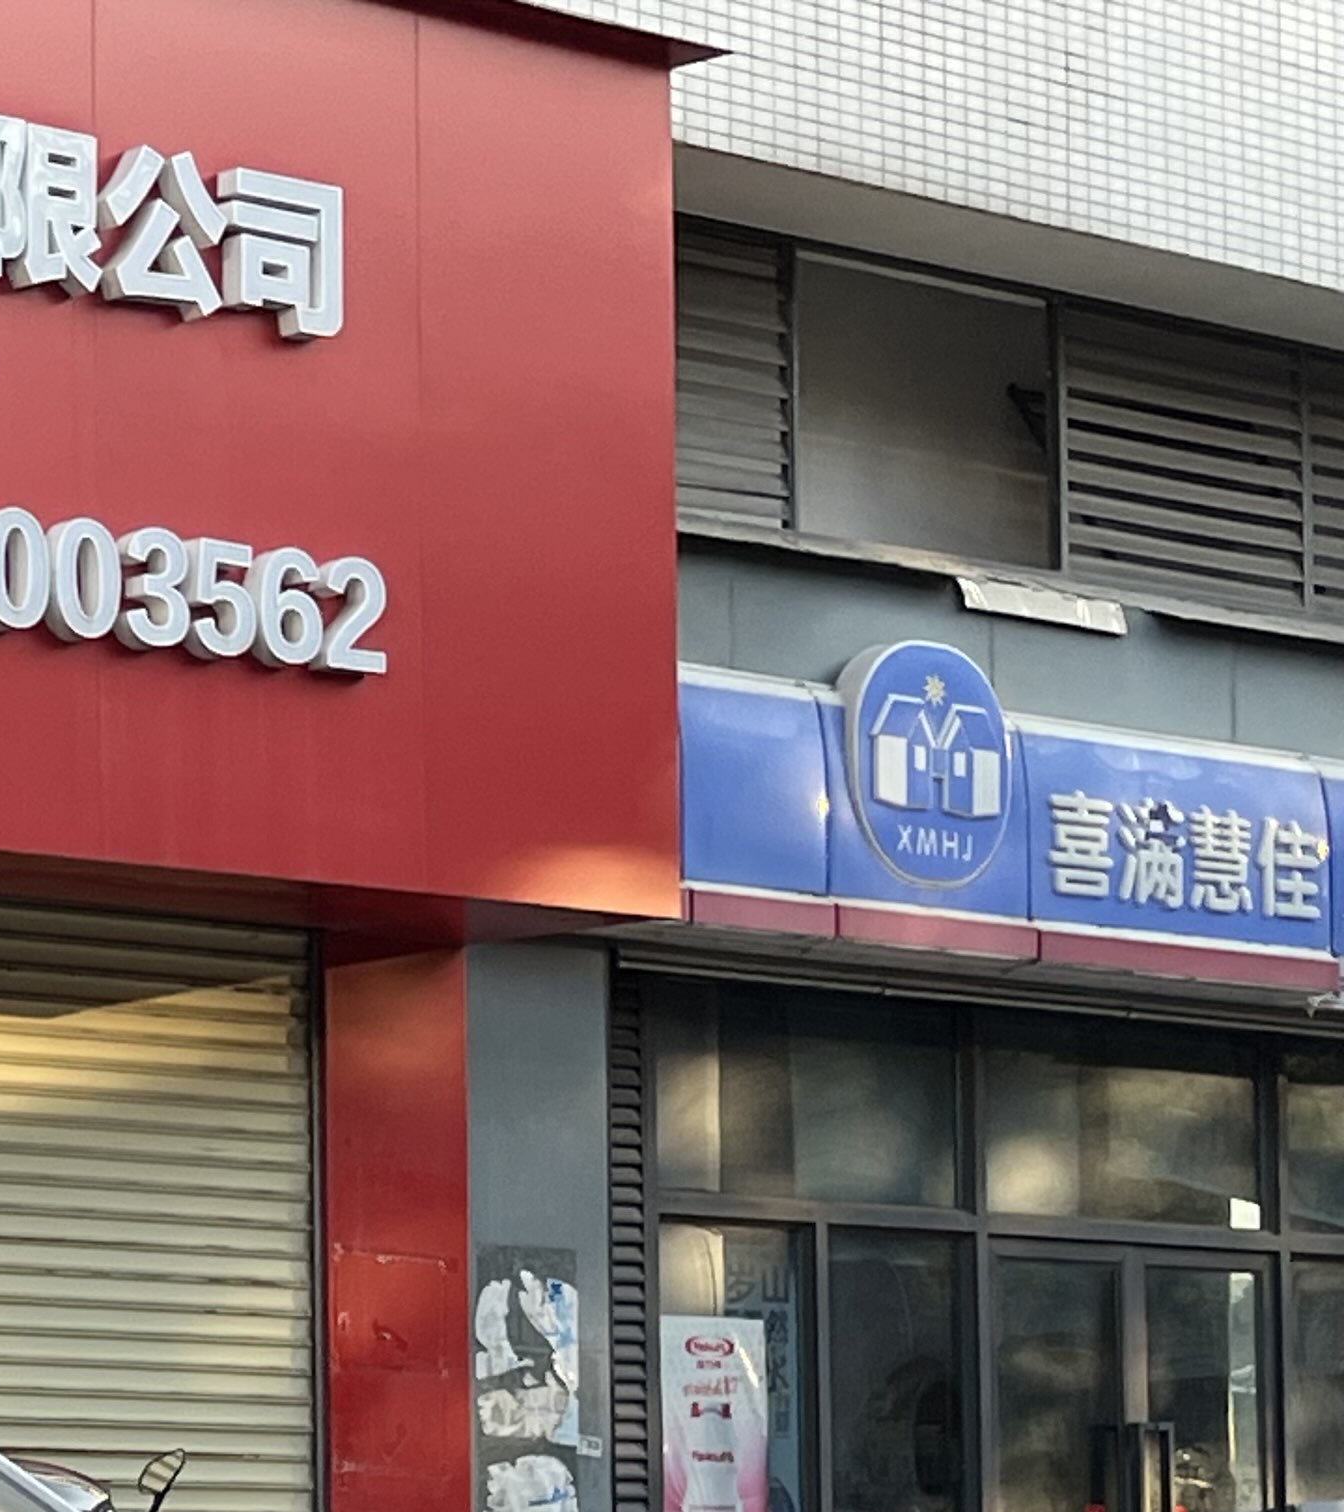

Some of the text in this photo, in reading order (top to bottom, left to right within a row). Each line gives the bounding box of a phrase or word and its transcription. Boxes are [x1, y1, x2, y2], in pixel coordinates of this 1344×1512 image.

[896, 823, 973, 862] XMHJ
[1048, 790, 1323, 920] 喜满慧佳
